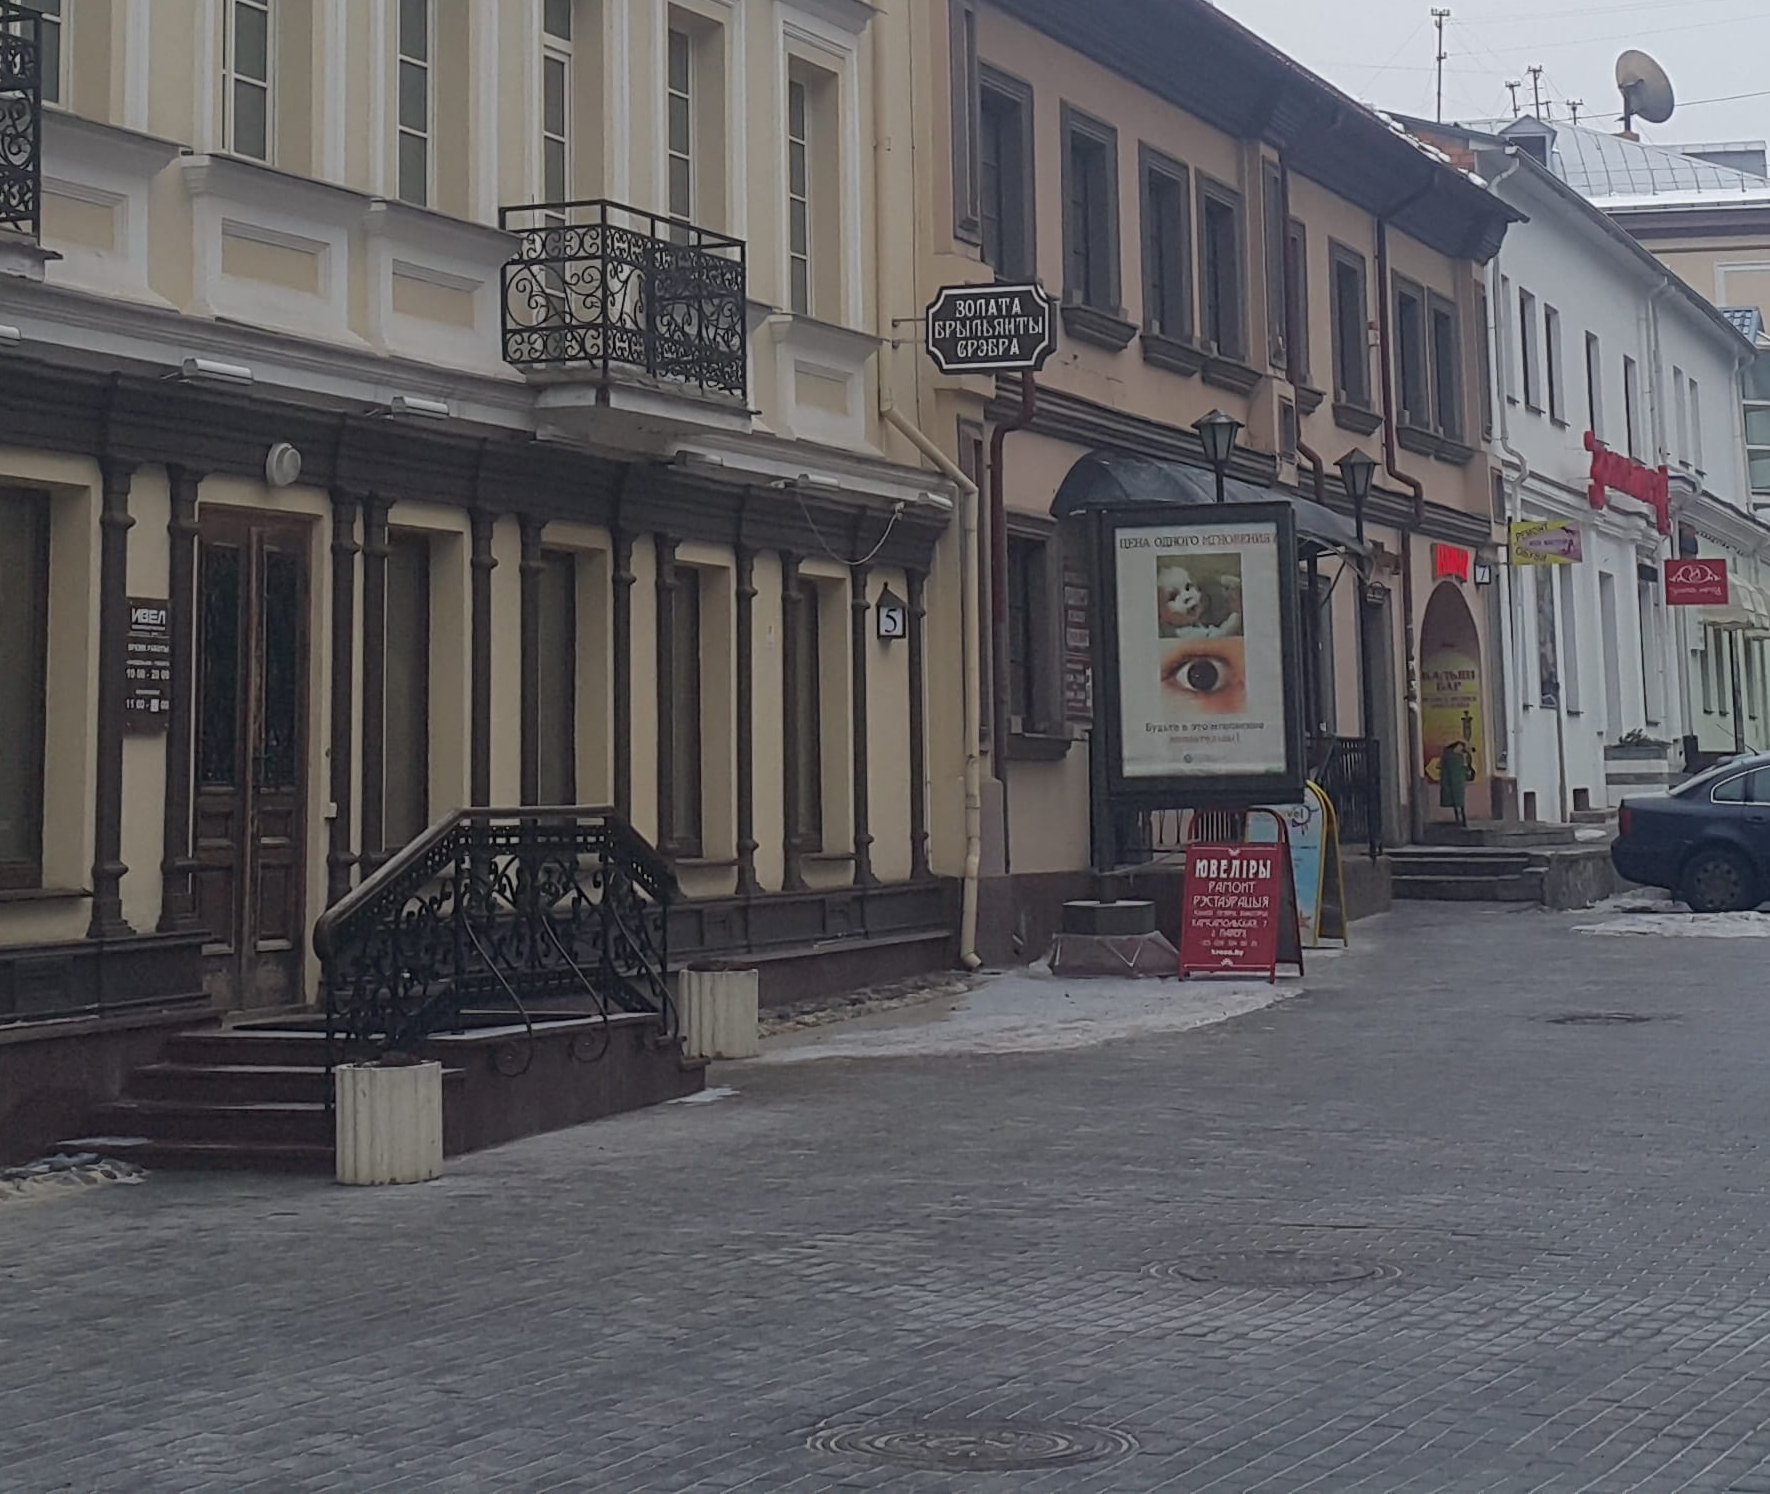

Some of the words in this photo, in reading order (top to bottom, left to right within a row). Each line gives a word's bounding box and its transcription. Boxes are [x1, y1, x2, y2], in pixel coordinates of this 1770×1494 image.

[955, 297, 1023, 318] ЗОЛАТА
[934, 316, 1043, 339] БРЫЛЬЯНТЫ
[957, 337, 1020, 358] СРЭБРА
[1120, 538, 1150, 549] ЦЕНА
[1154, 535, 1199, 547] ОДНОГО
[131, 608, 167, 625] ИВЕЛ
[885, 608, 897, 633] 5
[1195, 858, 1271, 879] ЮВЕЛІРЫ
[1208, 880, 1256, 894] РАМОНТ
